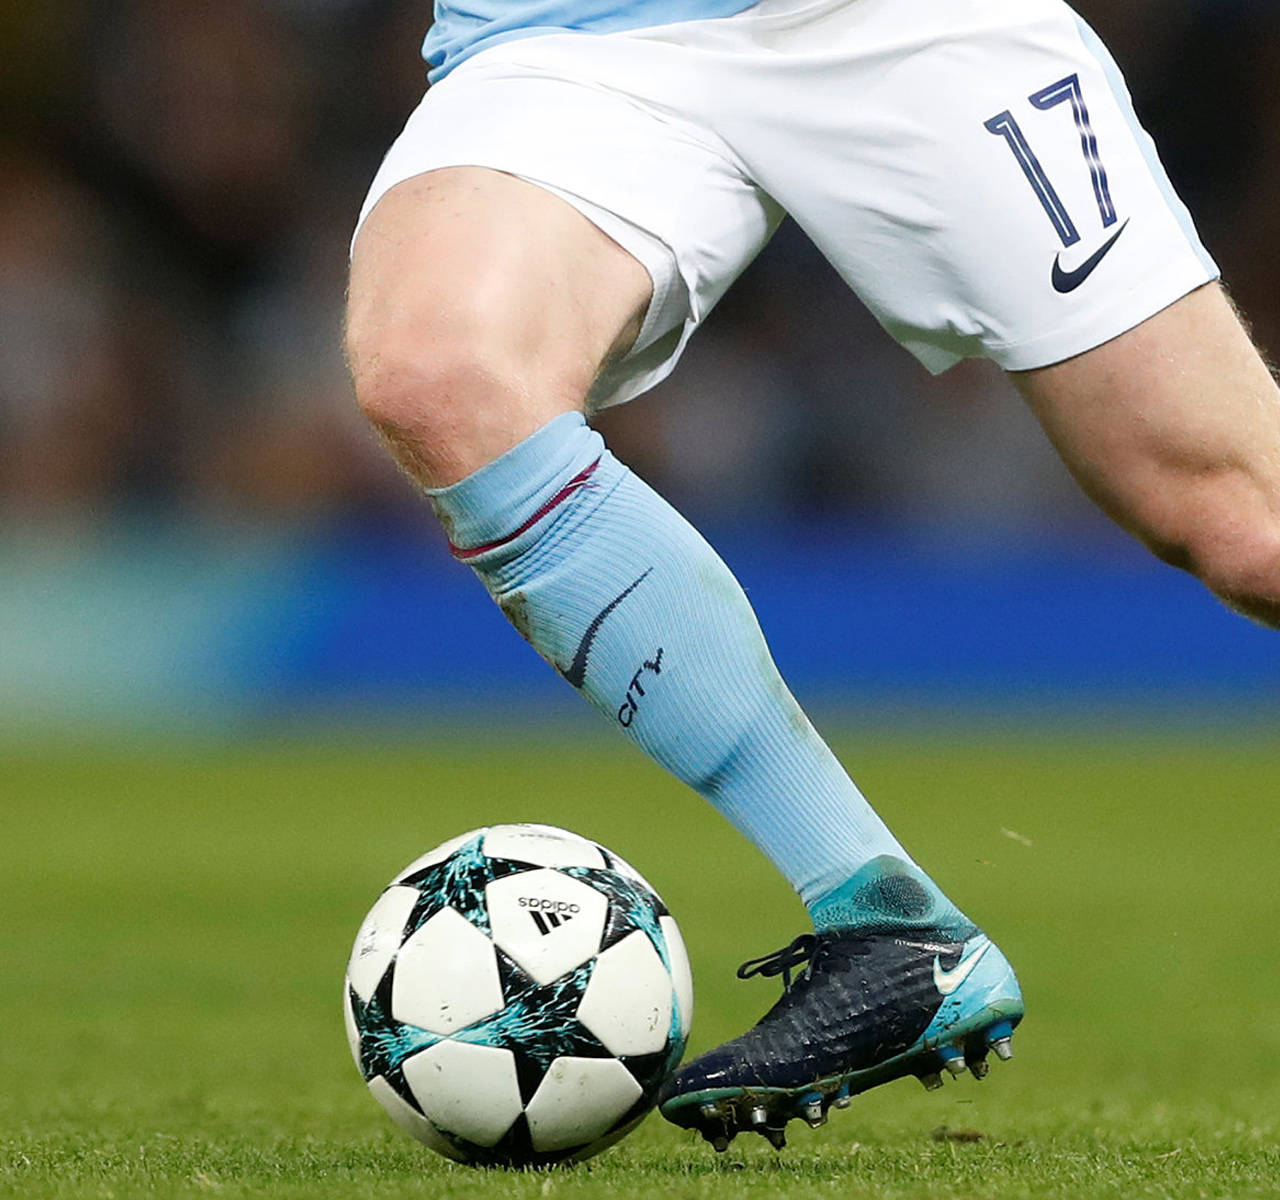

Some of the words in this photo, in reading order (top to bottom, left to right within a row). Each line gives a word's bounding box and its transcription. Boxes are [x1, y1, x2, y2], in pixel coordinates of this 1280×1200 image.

[983, 72, 1118, 249] 17
[618, 647, 664, 728] CITY
[517, 896, 581, 914] adidas
